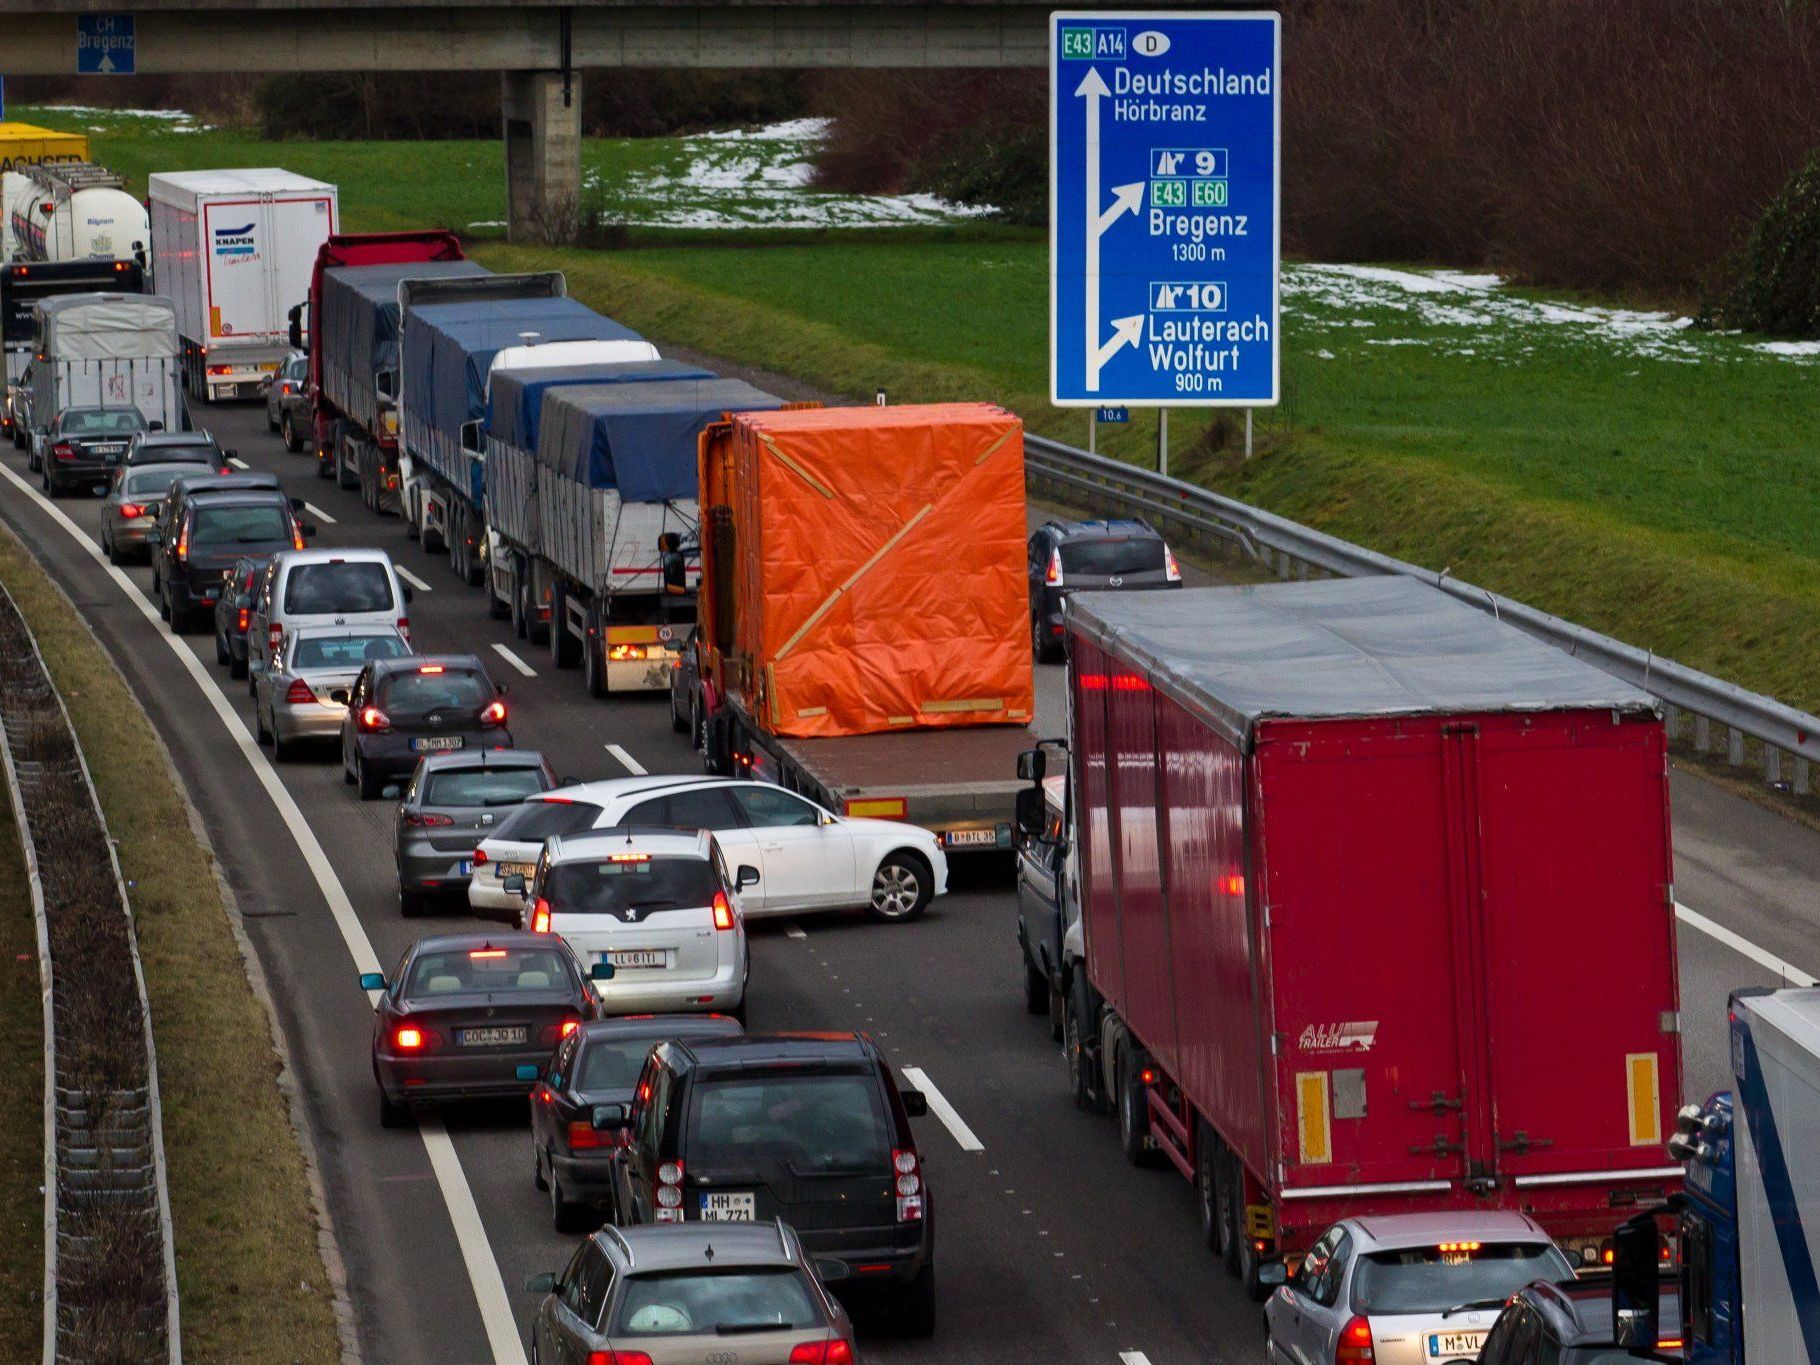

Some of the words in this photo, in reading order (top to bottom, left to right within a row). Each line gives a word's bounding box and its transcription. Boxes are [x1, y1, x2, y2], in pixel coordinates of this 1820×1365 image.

[79, 31, 133, 53] Bregenz
[1064, 33, 1092, 54] E43
[1097, 33, 1123, 54] A14
[1146, 35, 1157, 52] D
[1114, 67, 1271, 95] Deutschland
[1114, 98, 1206, 122] Hörbranz
[1195, 152, 1216, 176] 9
[1153, 183, 1184, 204] E43
[1194, 183, 1225, 204] E60
[1150, 208, 1247, 243] Bregenz
[216, 237, 254, 246] KNAPEN
[1172, 244, 1206, 261] 1300
[1211, 247, 1225, 261] m
[1187, 284, 1222, 310] 10
[1149, 314, 1269, 342] Lauterach
[1149, 344, 1240, 371] Wolfurt
[1175, 374, 1203, 392] 900
[1208, 377, 1222, 392] m
[1300, 1022, 1345, 1038] ALU
[1299, 1034, 1340, 1049] TRAILER
[711, 1194, 730, 1209] HH
[726, 1209, 750, 1221] 771
[1445, 1337, 1455, 1351] M
